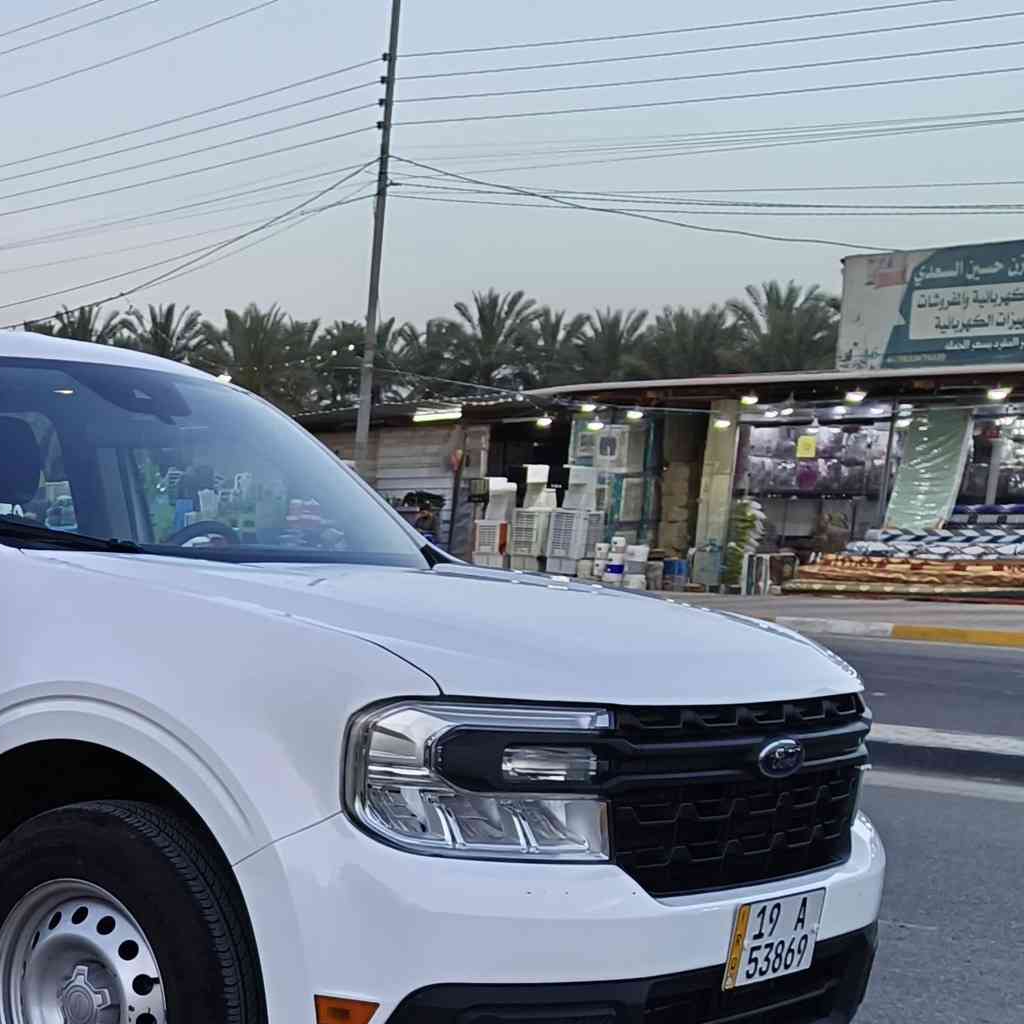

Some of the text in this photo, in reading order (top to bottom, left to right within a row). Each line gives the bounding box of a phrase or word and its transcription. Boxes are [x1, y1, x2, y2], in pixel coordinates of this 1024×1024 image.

[752, 897, 808, 942] 19 A
[745, 934, 809, 980] 53869
